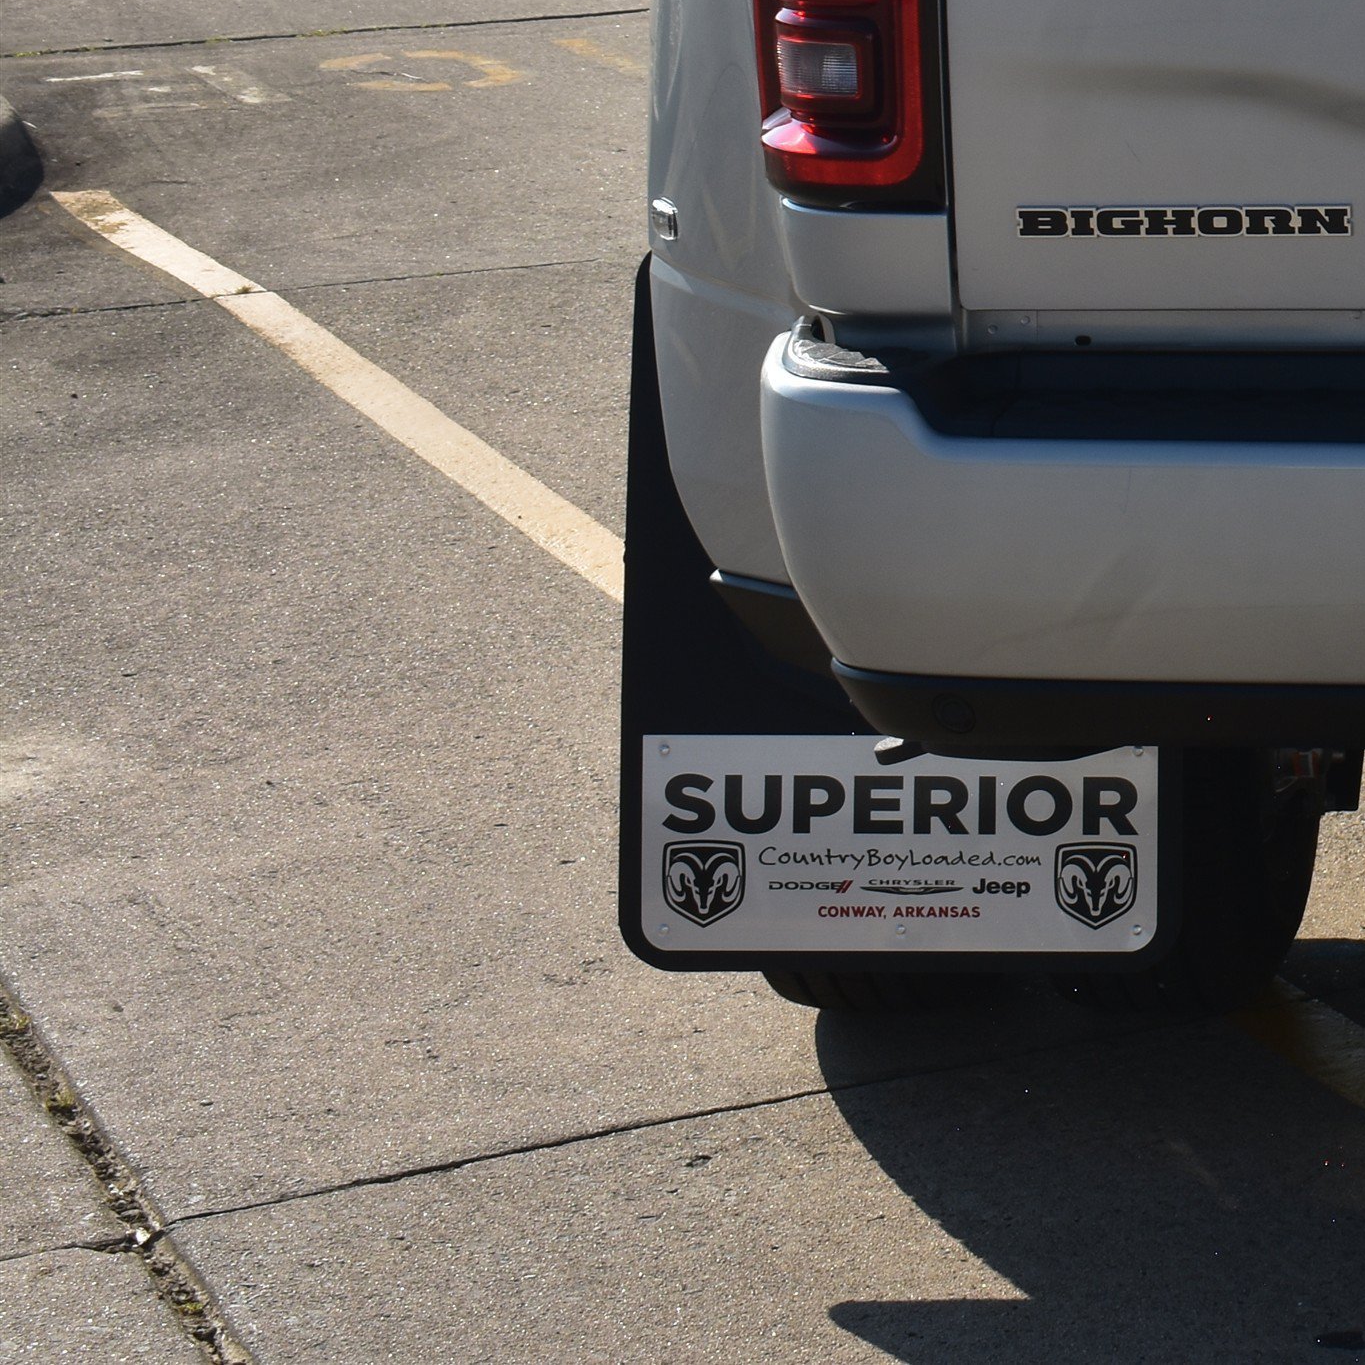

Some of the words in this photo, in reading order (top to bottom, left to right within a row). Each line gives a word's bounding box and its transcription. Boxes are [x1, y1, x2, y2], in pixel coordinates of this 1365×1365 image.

[1017, 206, 1352, 237] BIGHORN
[661, 773, 1139, 835] SUPERIOR
[758, 846, 1042, 871] CountryBoyLoaded.com
[768, 880, 844, 891] DODGE
[972, 878, 1031, 897] Jeep
[818, 905, 887, 920] CONWAY,
[893, 905, 981, 918] ARKANSAS
